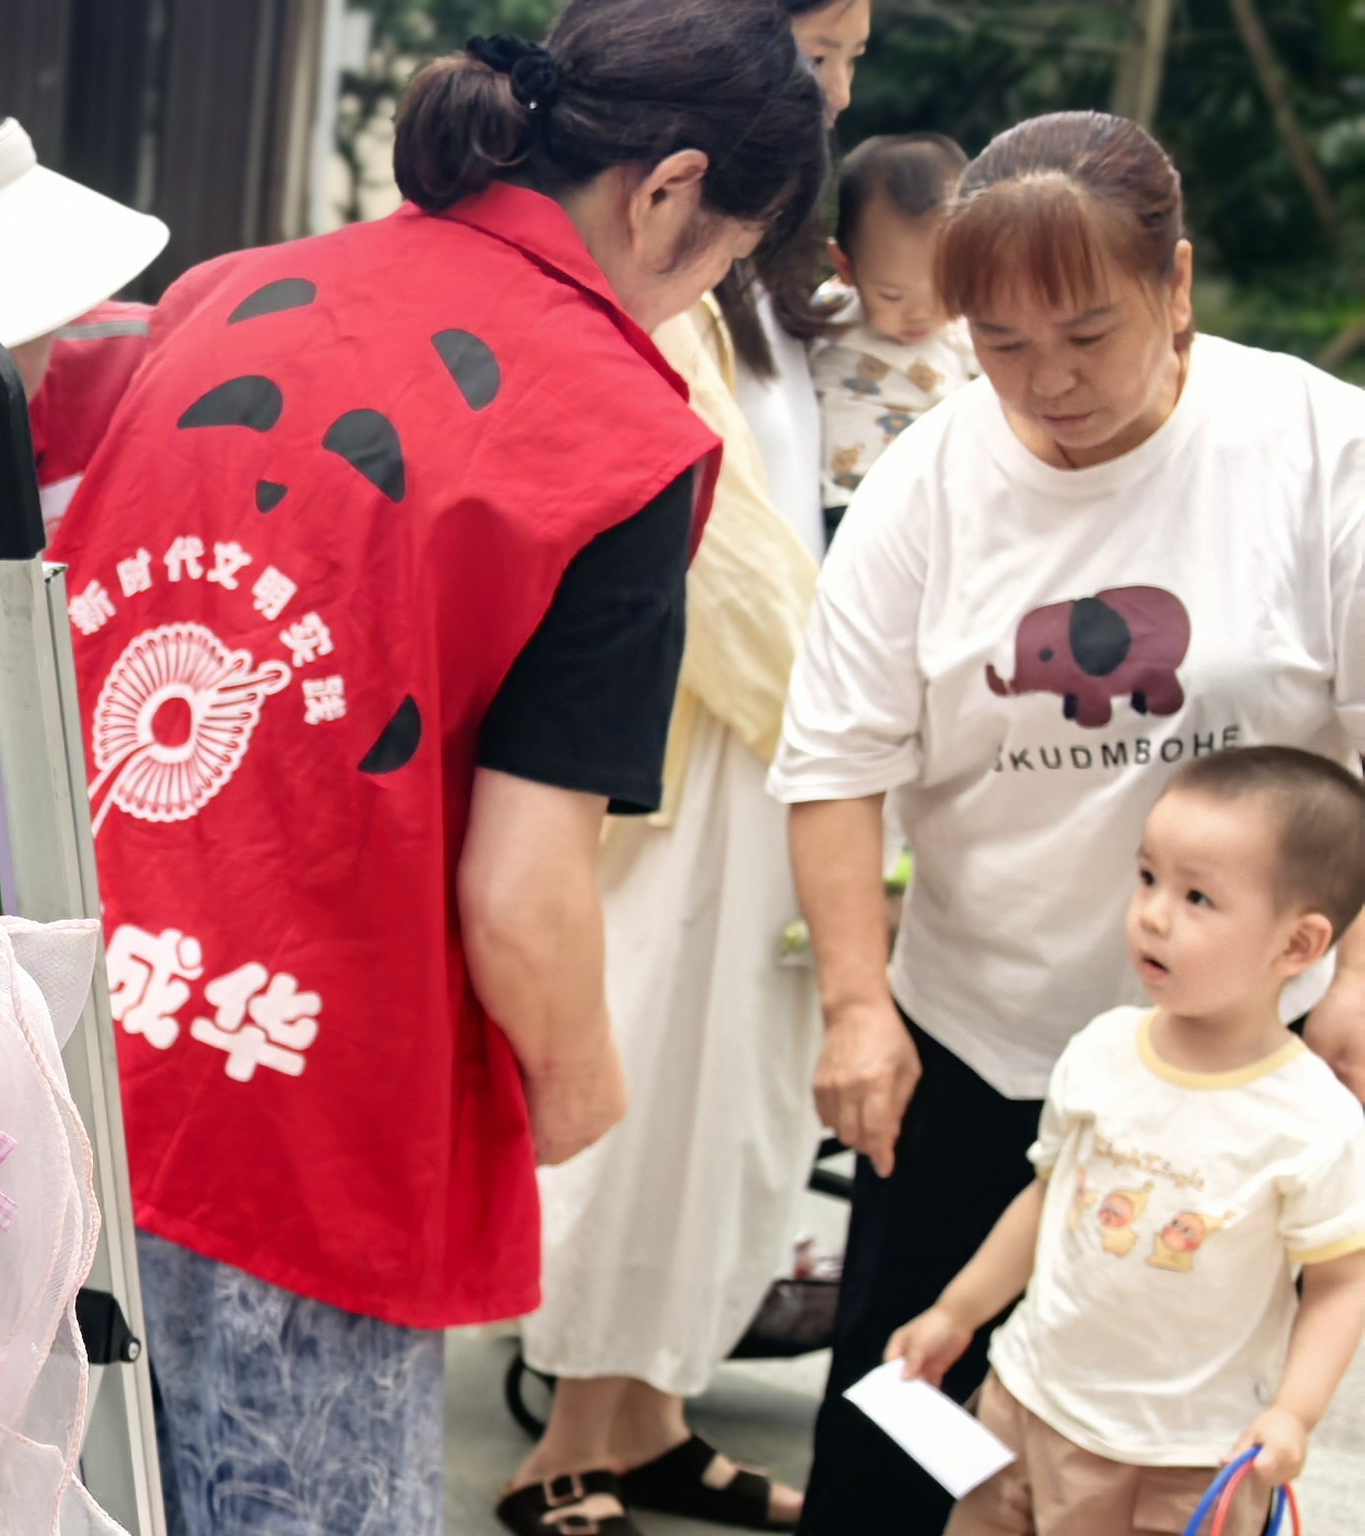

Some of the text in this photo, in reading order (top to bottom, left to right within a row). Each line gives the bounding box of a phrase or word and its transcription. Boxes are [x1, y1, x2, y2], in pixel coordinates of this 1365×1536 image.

[69, 536, 346, 725] 新时代文明实践
